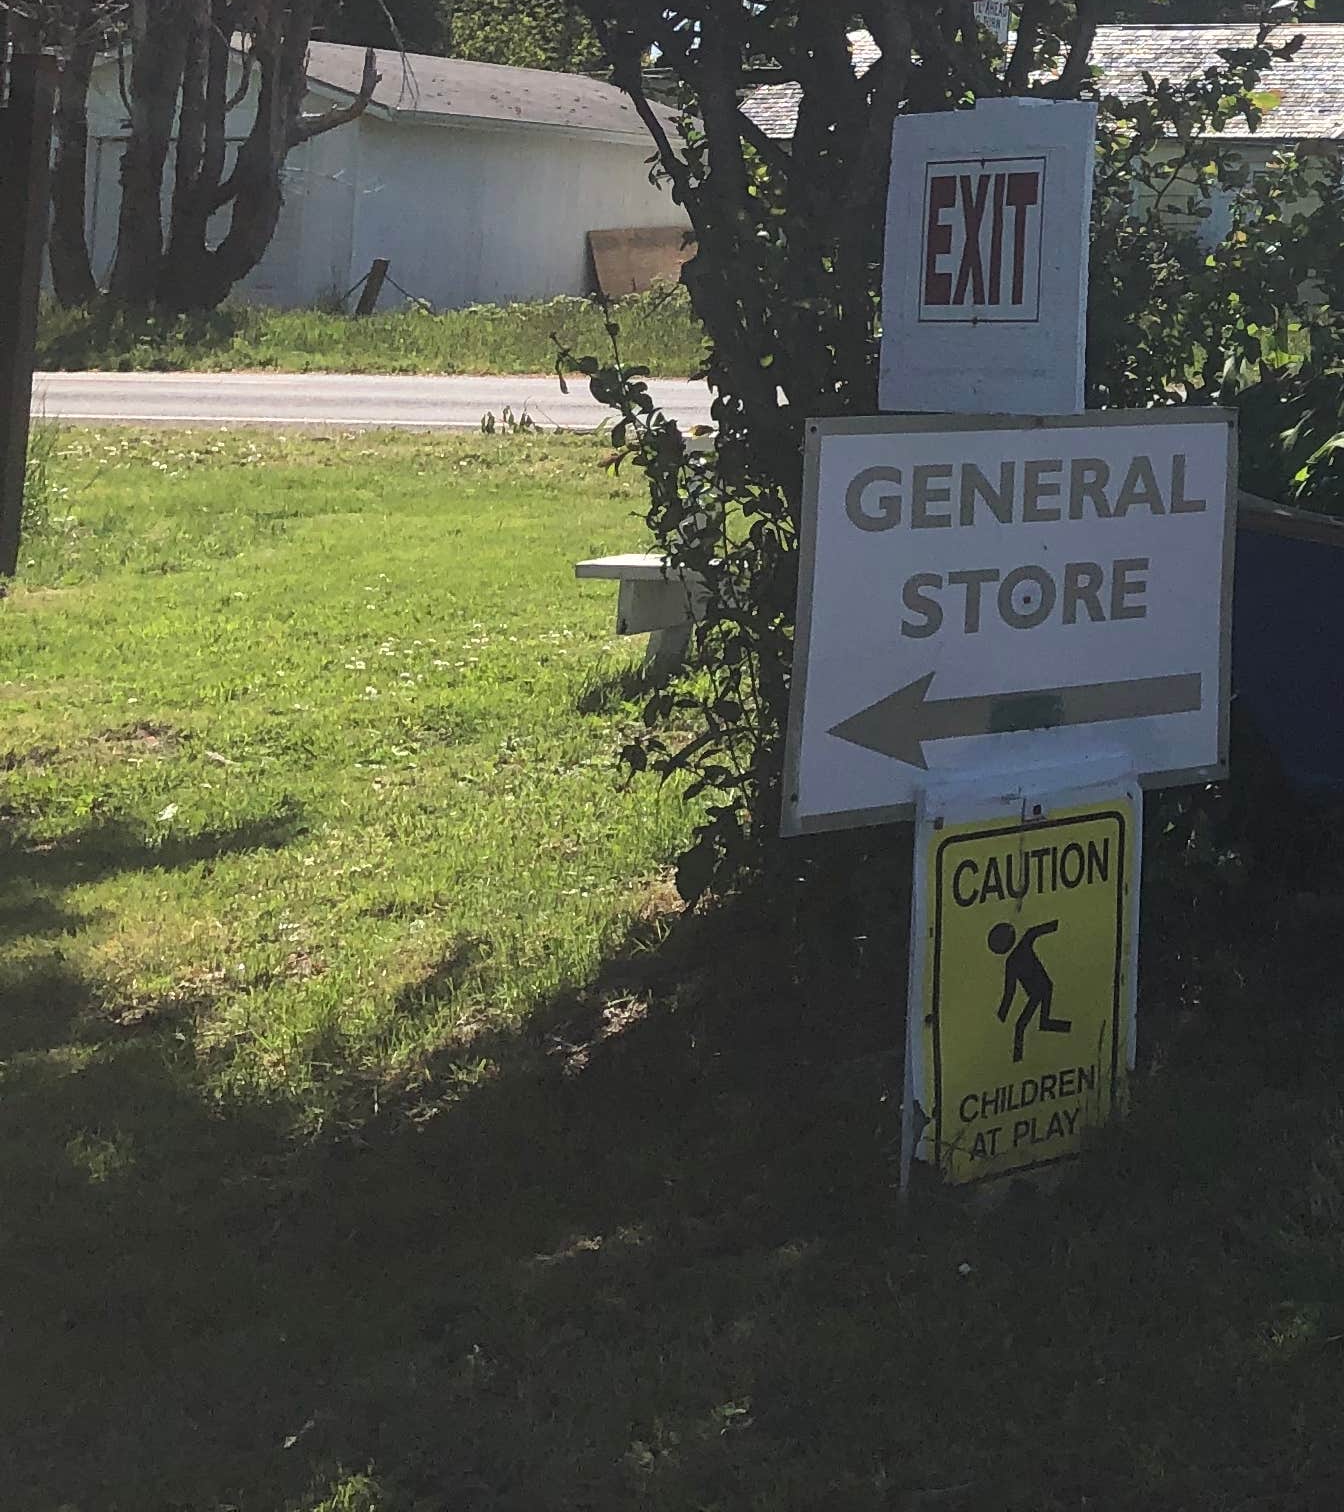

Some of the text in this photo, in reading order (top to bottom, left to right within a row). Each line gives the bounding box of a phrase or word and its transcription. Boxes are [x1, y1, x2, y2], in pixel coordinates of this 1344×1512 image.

[924, 172, 1038, 306] EXIT
[845, 453, 1207, 533] GENERAL
[901, 557, 1150, 639] STORE
[953, 838, 1109, 907] CAUTION
[959, 1065, 1096, 1123] CHILDREN
[969, 1107, 1080, 1161] AT PLAY
